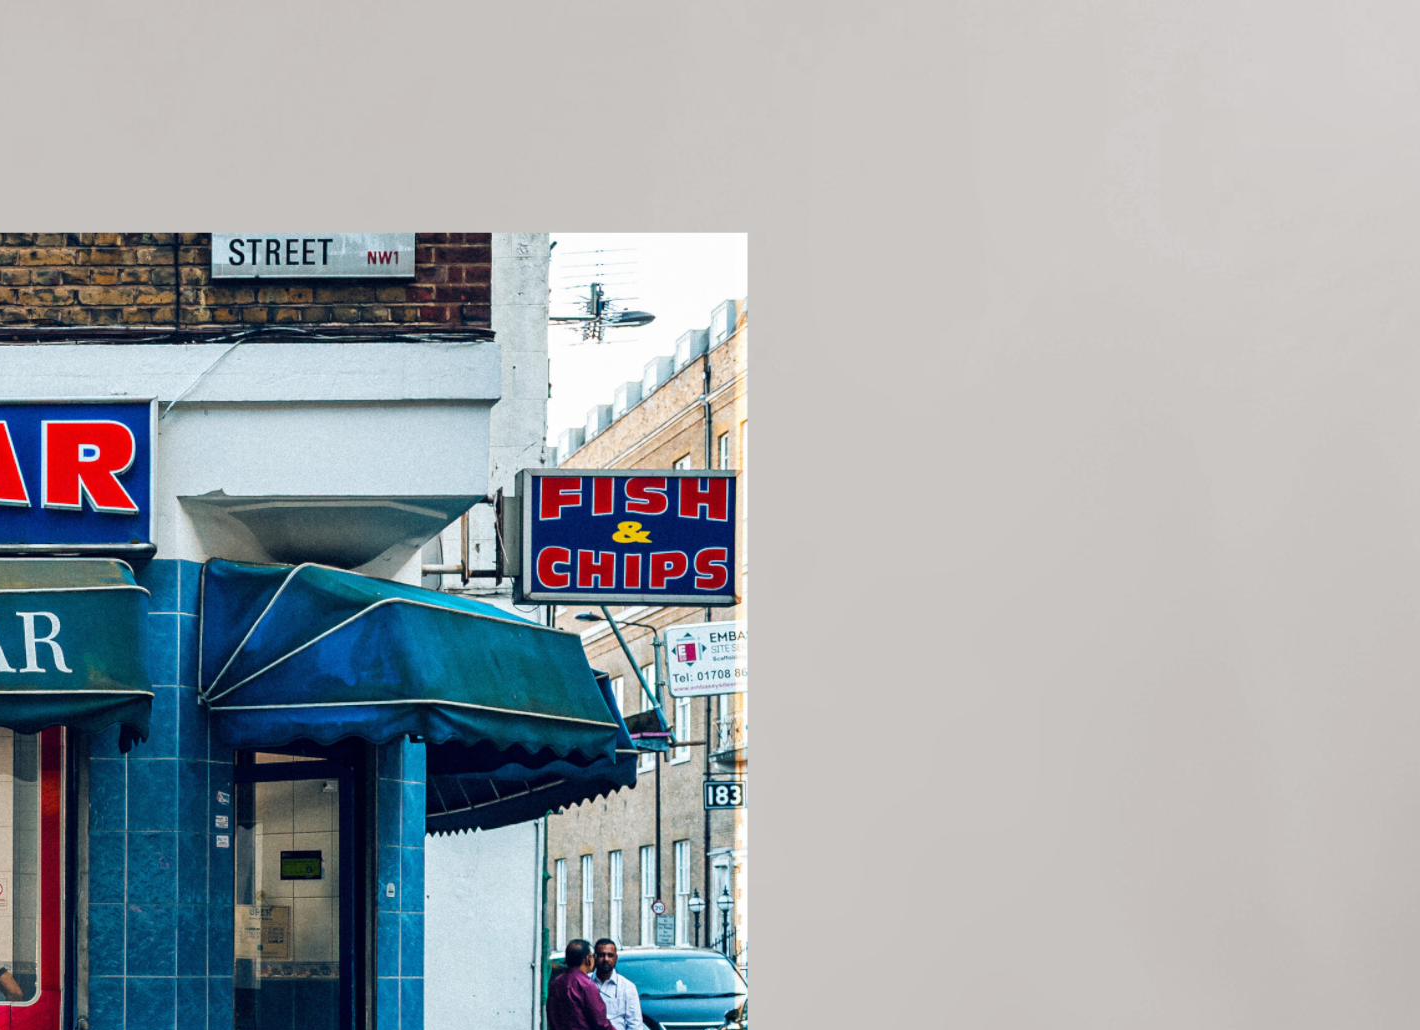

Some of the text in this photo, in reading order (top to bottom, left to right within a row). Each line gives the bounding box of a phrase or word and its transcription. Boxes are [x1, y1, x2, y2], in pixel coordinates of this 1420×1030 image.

[229, 238, 333, 266] STREET
[367, 251, 399, 265] NW1
[539, 476, 729, 522] FISH
[612, 521, 653, 544] &
[536, 545, 729, 590] CHIPS
[709, 631, 748, 643] EMBA
[710, 644, 730, 654] SITE
[673, 672, 694, 683] Tel:
[697, 669, 731, 680] 01708
[708, 785, 741, 806] 183
